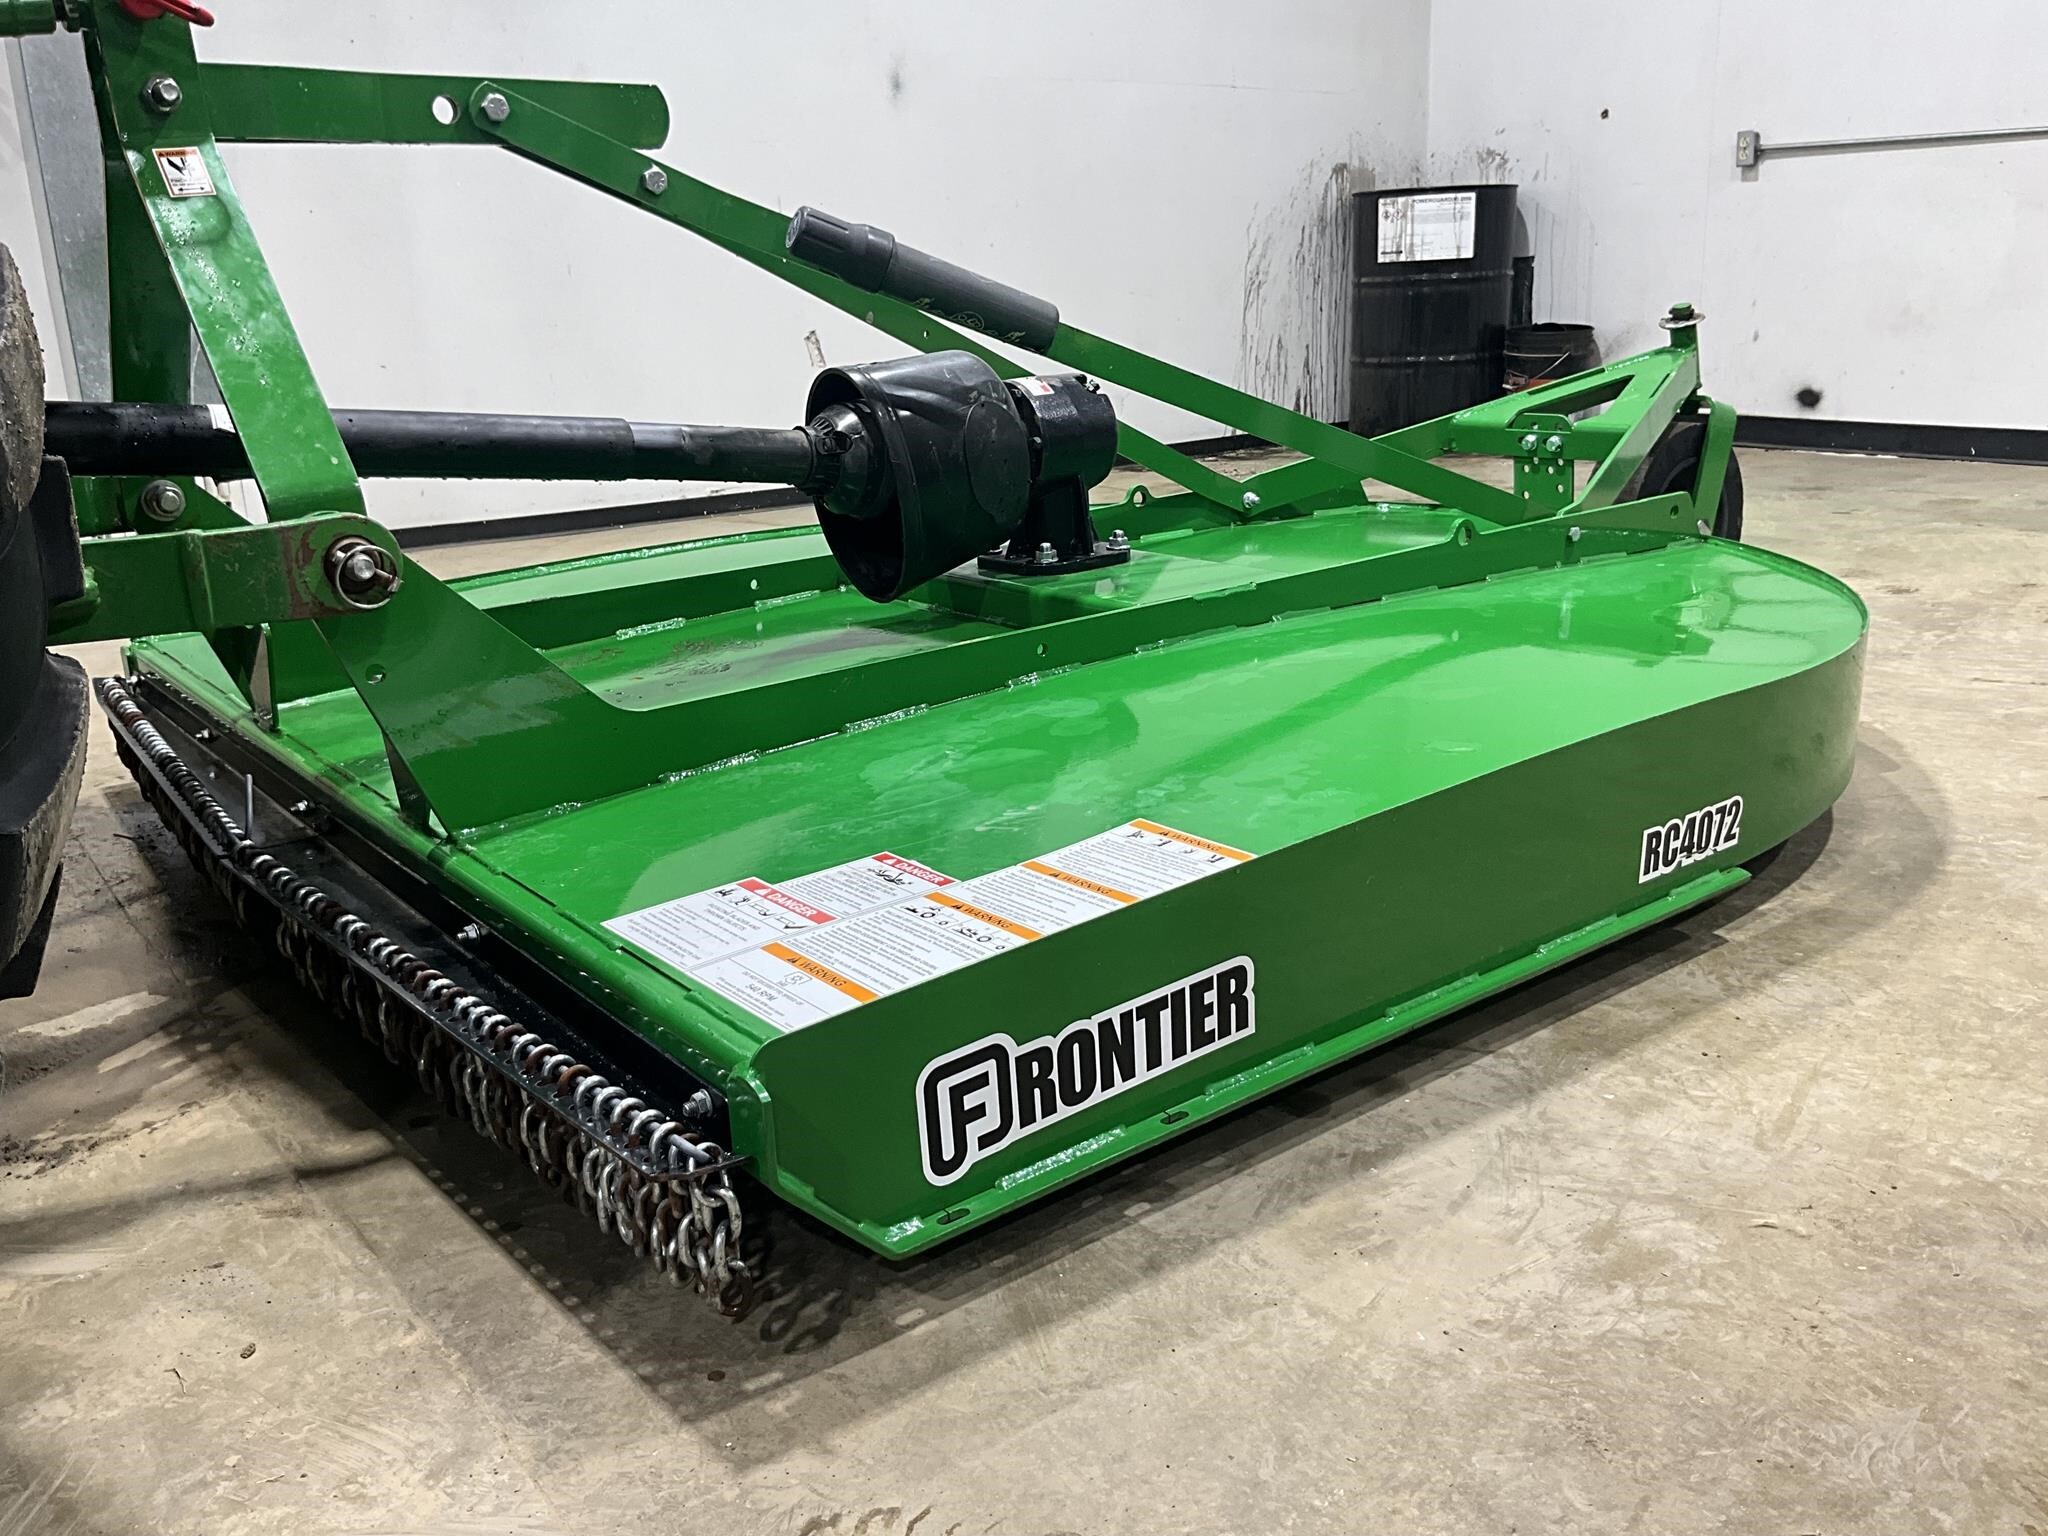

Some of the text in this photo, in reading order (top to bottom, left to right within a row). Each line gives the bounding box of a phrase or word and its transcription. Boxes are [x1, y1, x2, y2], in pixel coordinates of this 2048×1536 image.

[1173, 834, 1223, 851] WARNING
[1643, 799, 1740, 876] RC4072
[895, 862, 945, 882] DANGER
[1060, 874, 1114, 894] WARNING
[766, 892, 820, 916] DANGER
[964, 907, 1012, 928] WARNING
[799, 961, 847, 987] WARNING
[924, 965, 1249, 1177] FRONTIER
